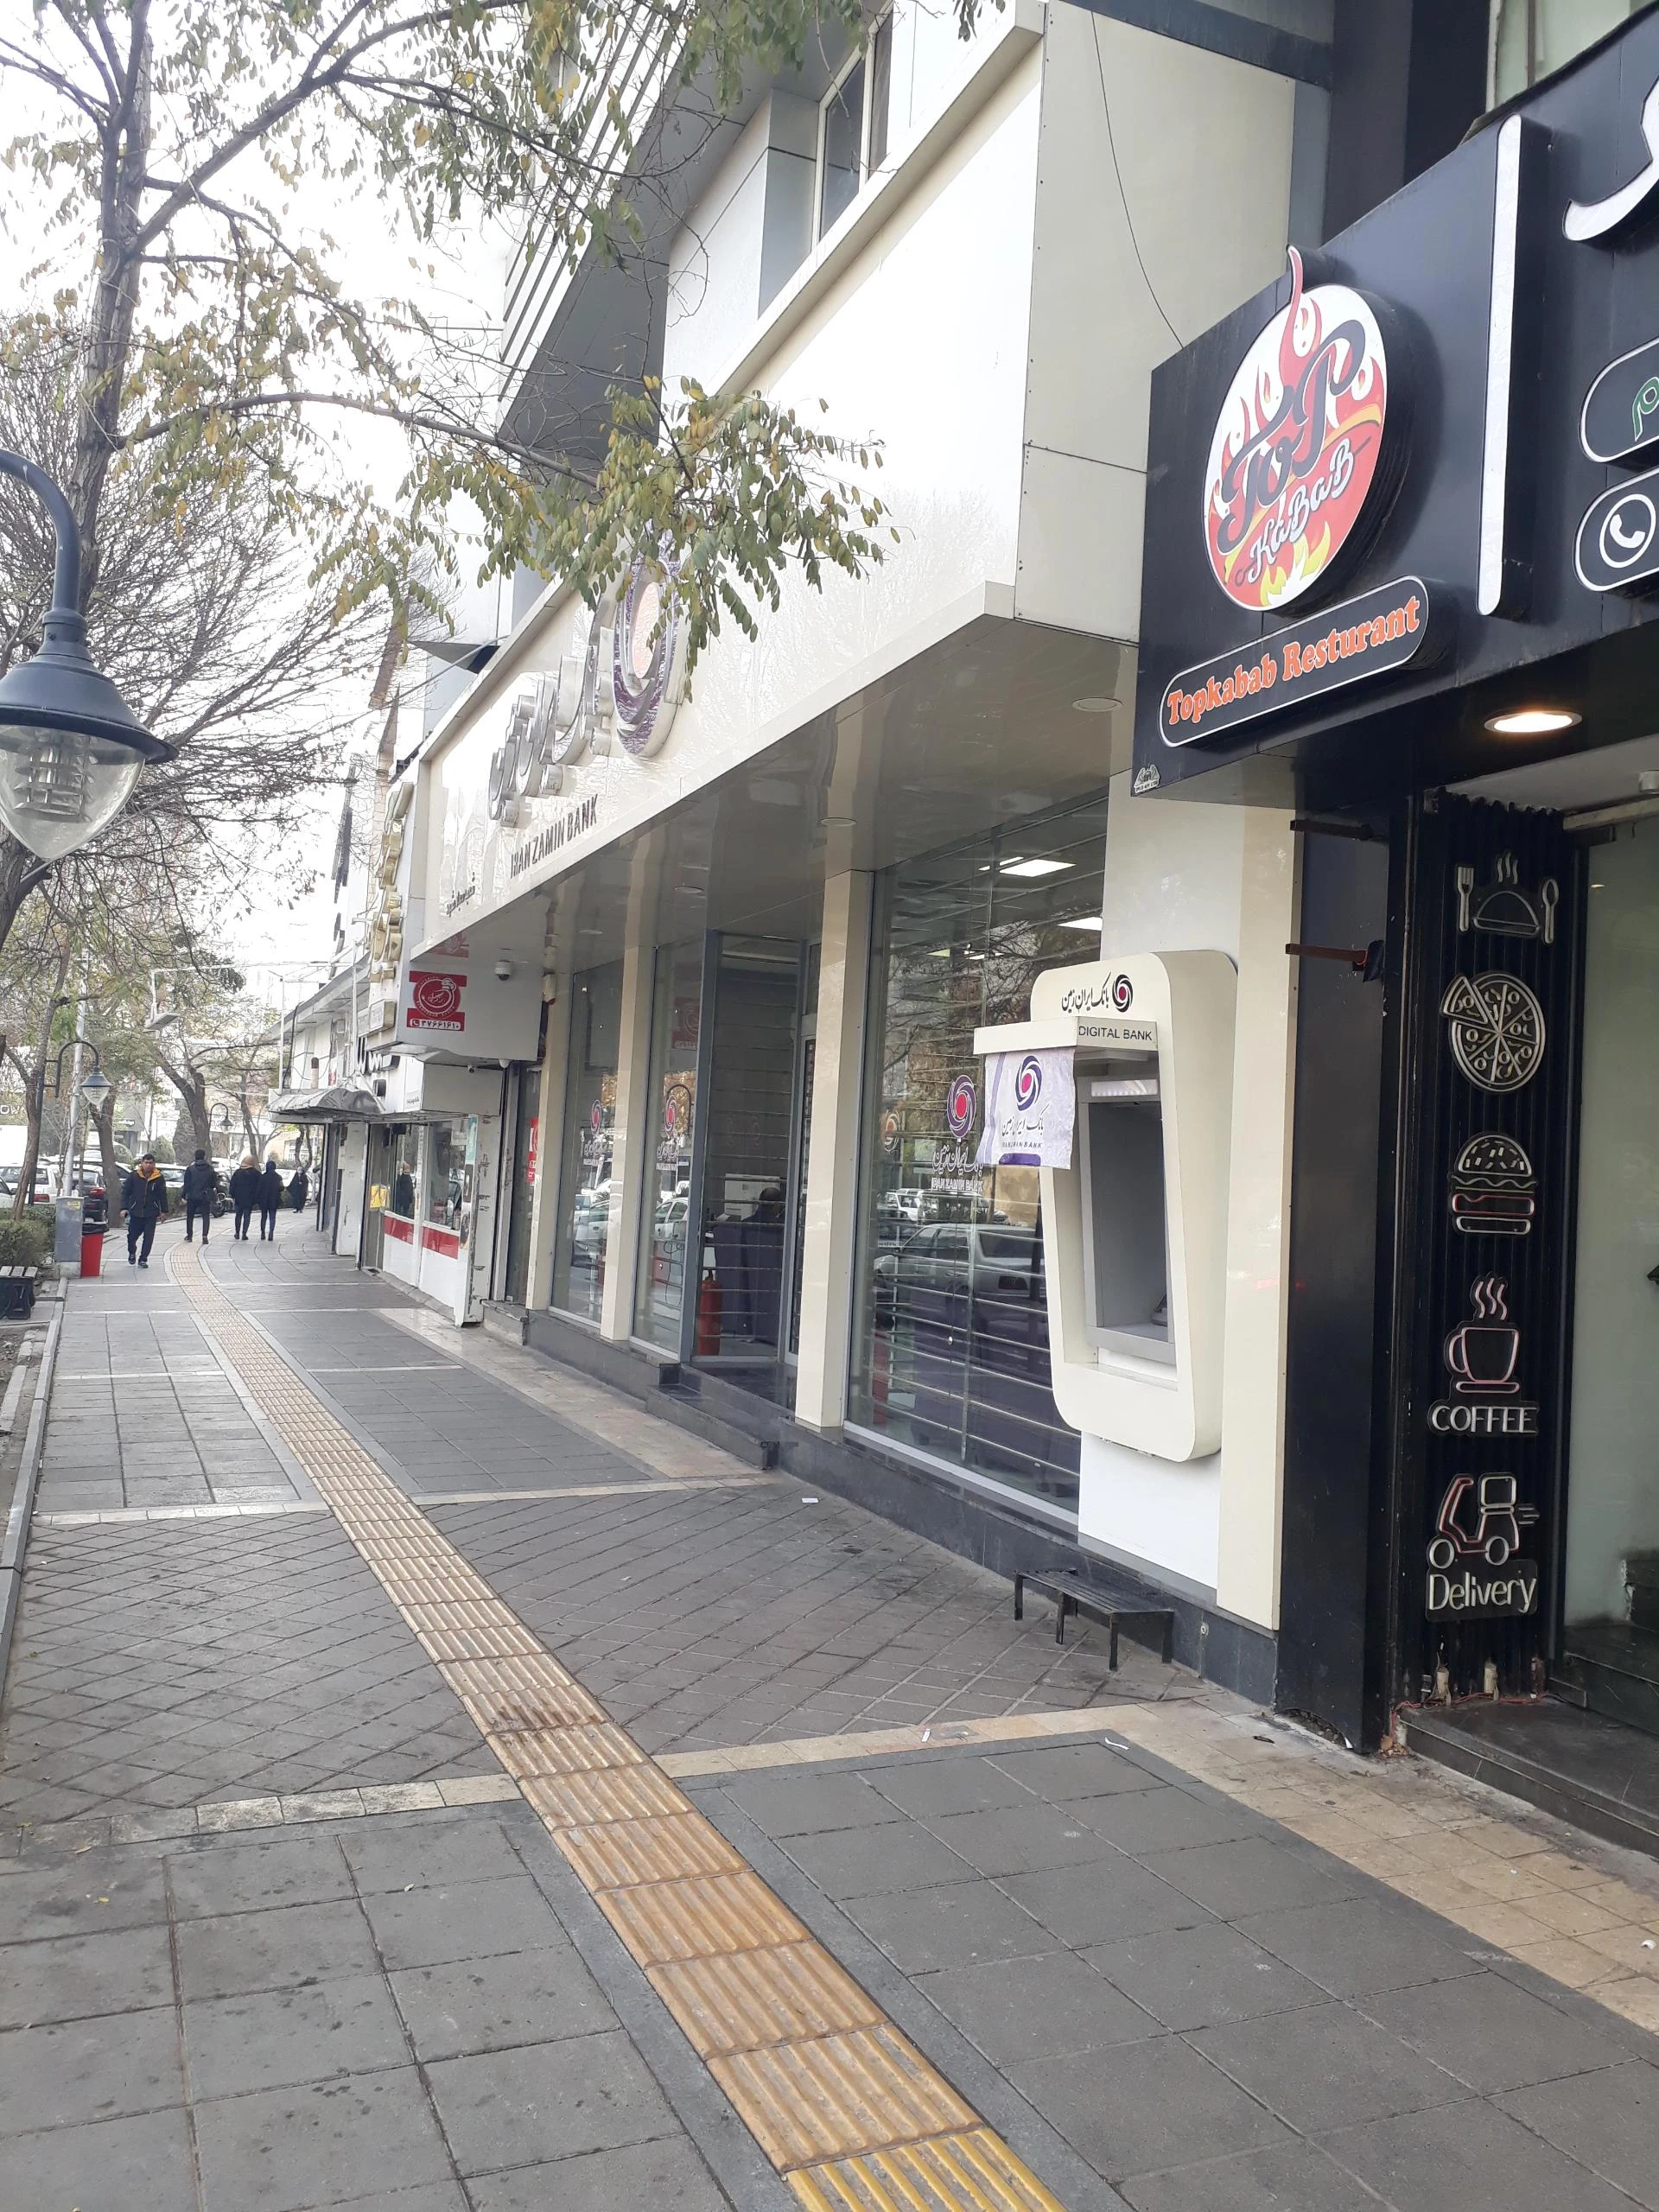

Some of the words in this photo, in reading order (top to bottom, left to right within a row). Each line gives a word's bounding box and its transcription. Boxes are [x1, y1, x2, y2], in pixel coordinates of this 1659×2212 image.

[1167, 652, 1278, 726] Topkabab
[1282, 595, 1421, 682] Resturant
[511, 842, 531, 879] IRAN
[532, 817, 565, 865] ZAMIN
[567, 793, 598, 842] BANK
[1061, 988, 1076, 1014] زمین
[1074, 987, 1093, 1012] ایران
[1091, 970, 1112, 1009] بانک
[1078, 1026, 1121, 1039] DIGITAL
[1123, 1029, 1153, 1041] BANK
[1027, 1103, 1051, 1135] بانک
[947, 1146, 969, 1176] ایران
[931, 1177, 945, 1191] IRAN
[945, 1178, 965, 1191] ZAMIN
[965, 1179, 983, 1192] BANK
[1431, 1404, 1538, 1433] COFFEE
[1428, 1572, 1537, 1613] Delivery
